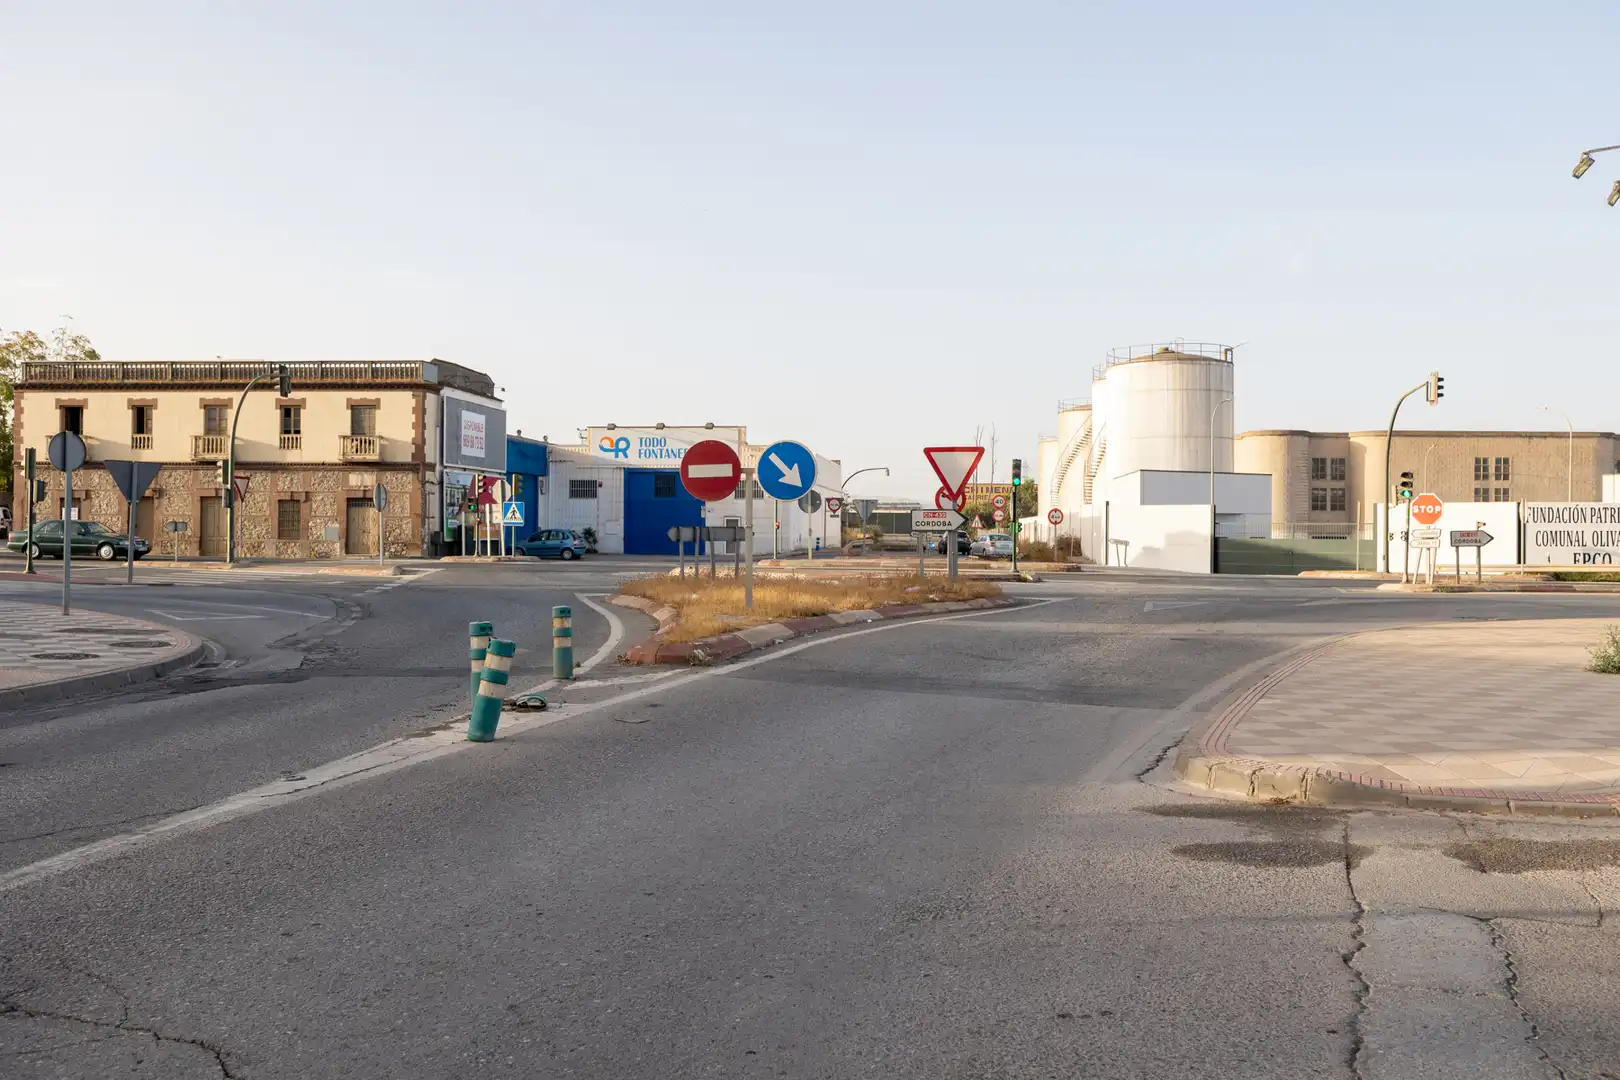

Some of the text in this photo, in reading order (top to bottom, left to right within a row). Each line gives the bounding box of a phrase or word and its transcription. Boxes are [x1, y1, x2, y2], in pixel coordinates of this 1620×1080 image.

[638, 436, 667, 448] TODO
[1413, 505, 1441, 514] STOP
[1535, 530, 1587, 547] COMUNAL
